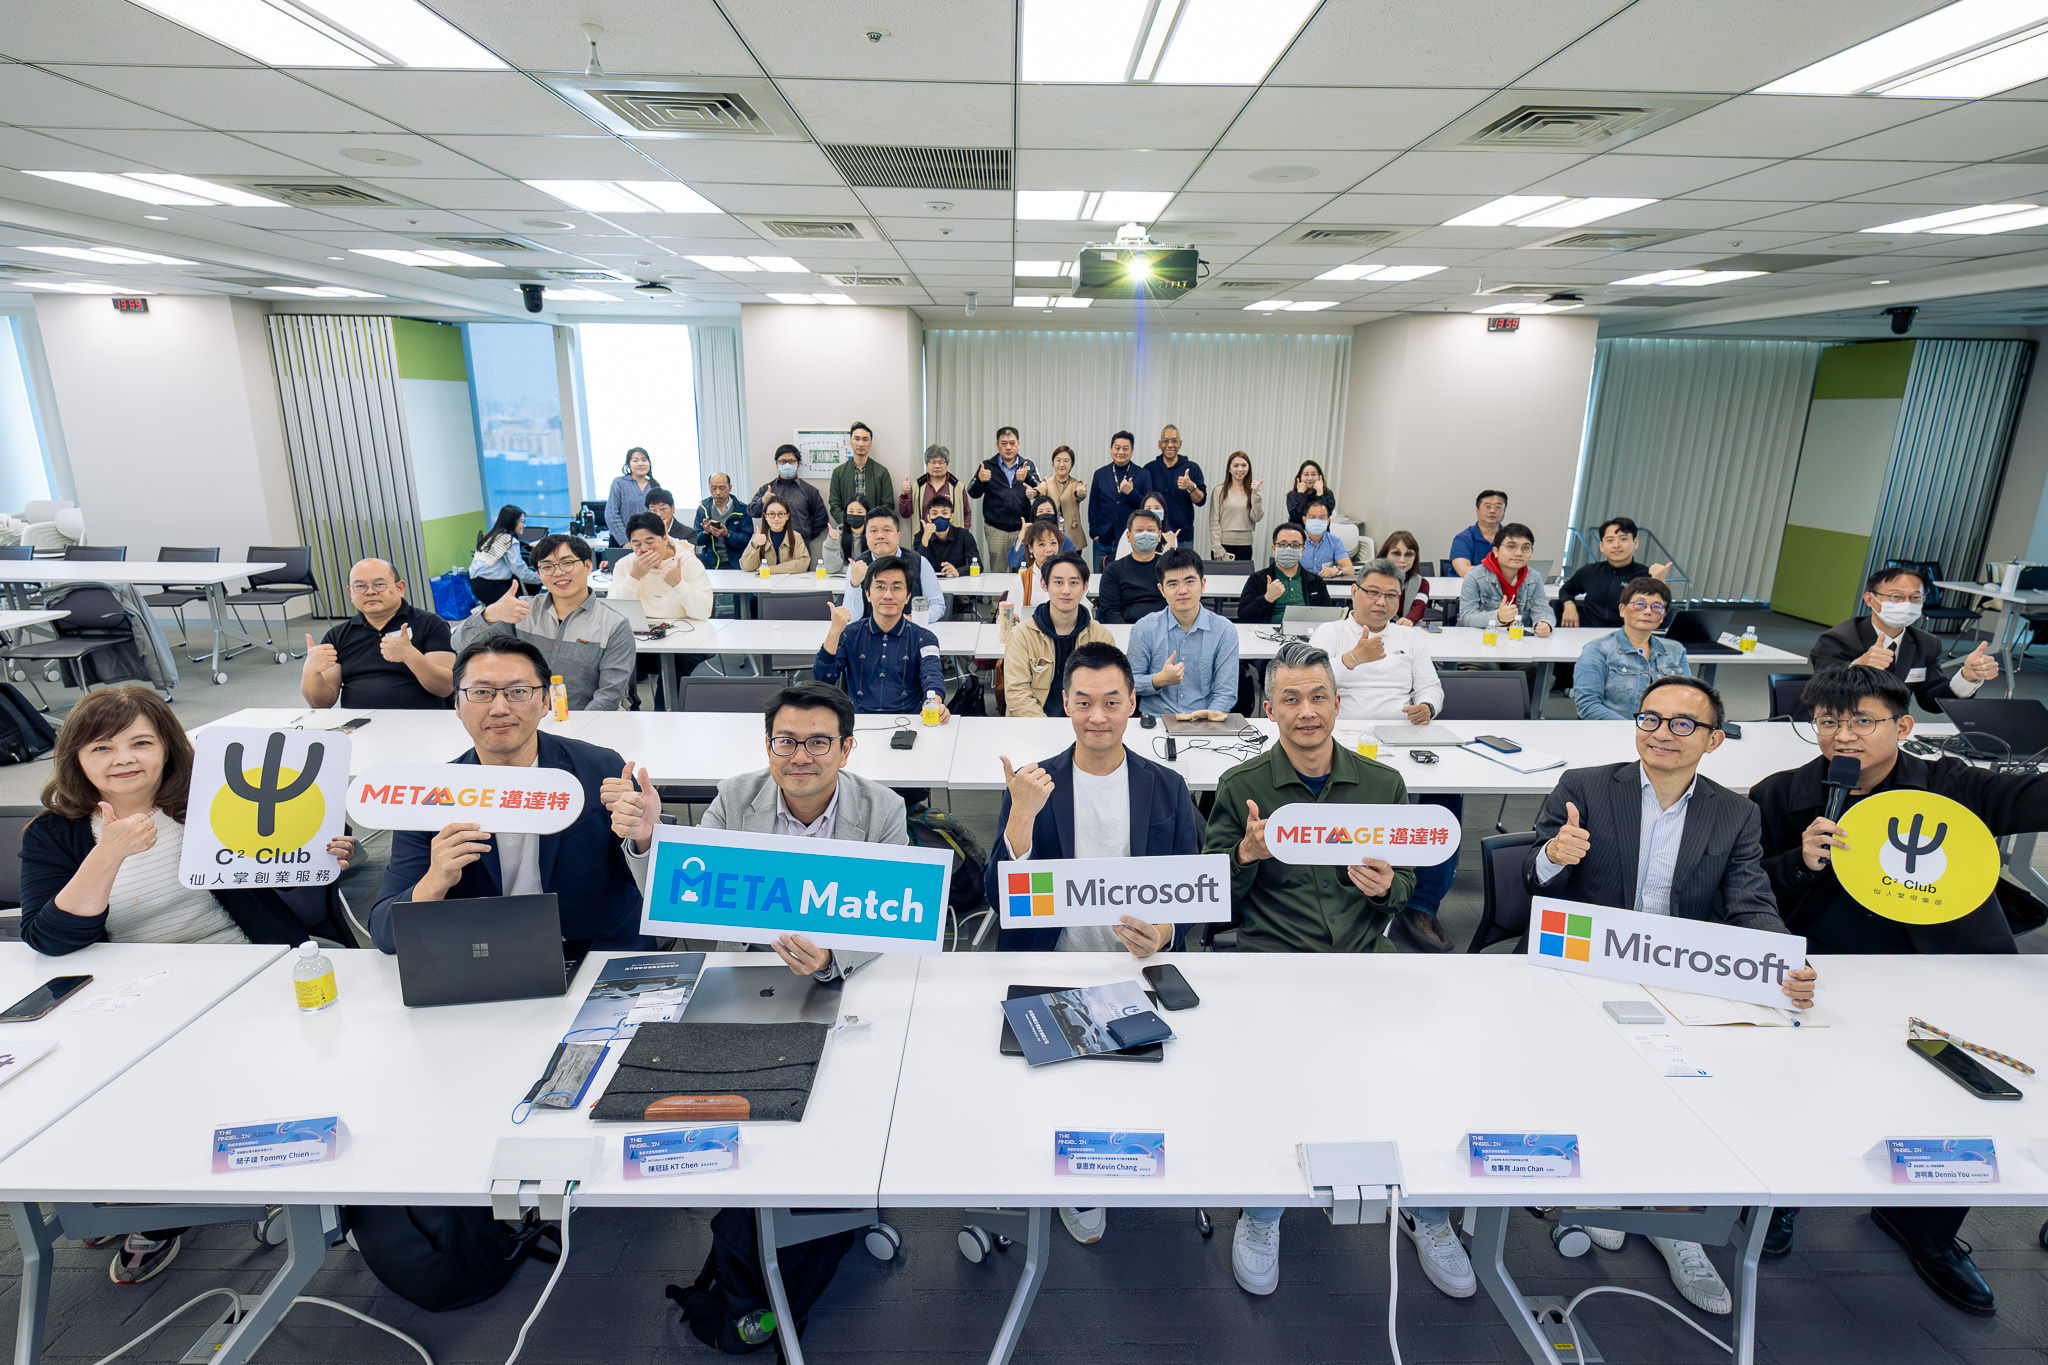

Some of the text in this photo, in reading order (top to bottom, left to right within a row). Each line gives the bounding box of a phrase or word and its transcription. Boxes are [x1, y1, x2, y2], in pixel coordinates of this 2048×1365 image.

[498, 790, 571, 811] 邁達特
[1388, 827, 1449, 846] 邁達特
[255, 847, 311, 864] Club
[189, 869, 331, 886] 仙人掌創業服務
[669, 867, 924, 924] META Match
[1065, 873, 1220, 907] Microsoft
[1903, 879, 1938, 895] Club
[1603, 927, 1790, 987] Microsoft
[260, 1154, 287, 1163] Tommy
[288, 1151, 310, 1159] Chien
[1116, 1163, 1138, 1172] Chang
[1934, 1170, 1957, 1178] Dennis
[1957, 1170, 1970, 1178] You
